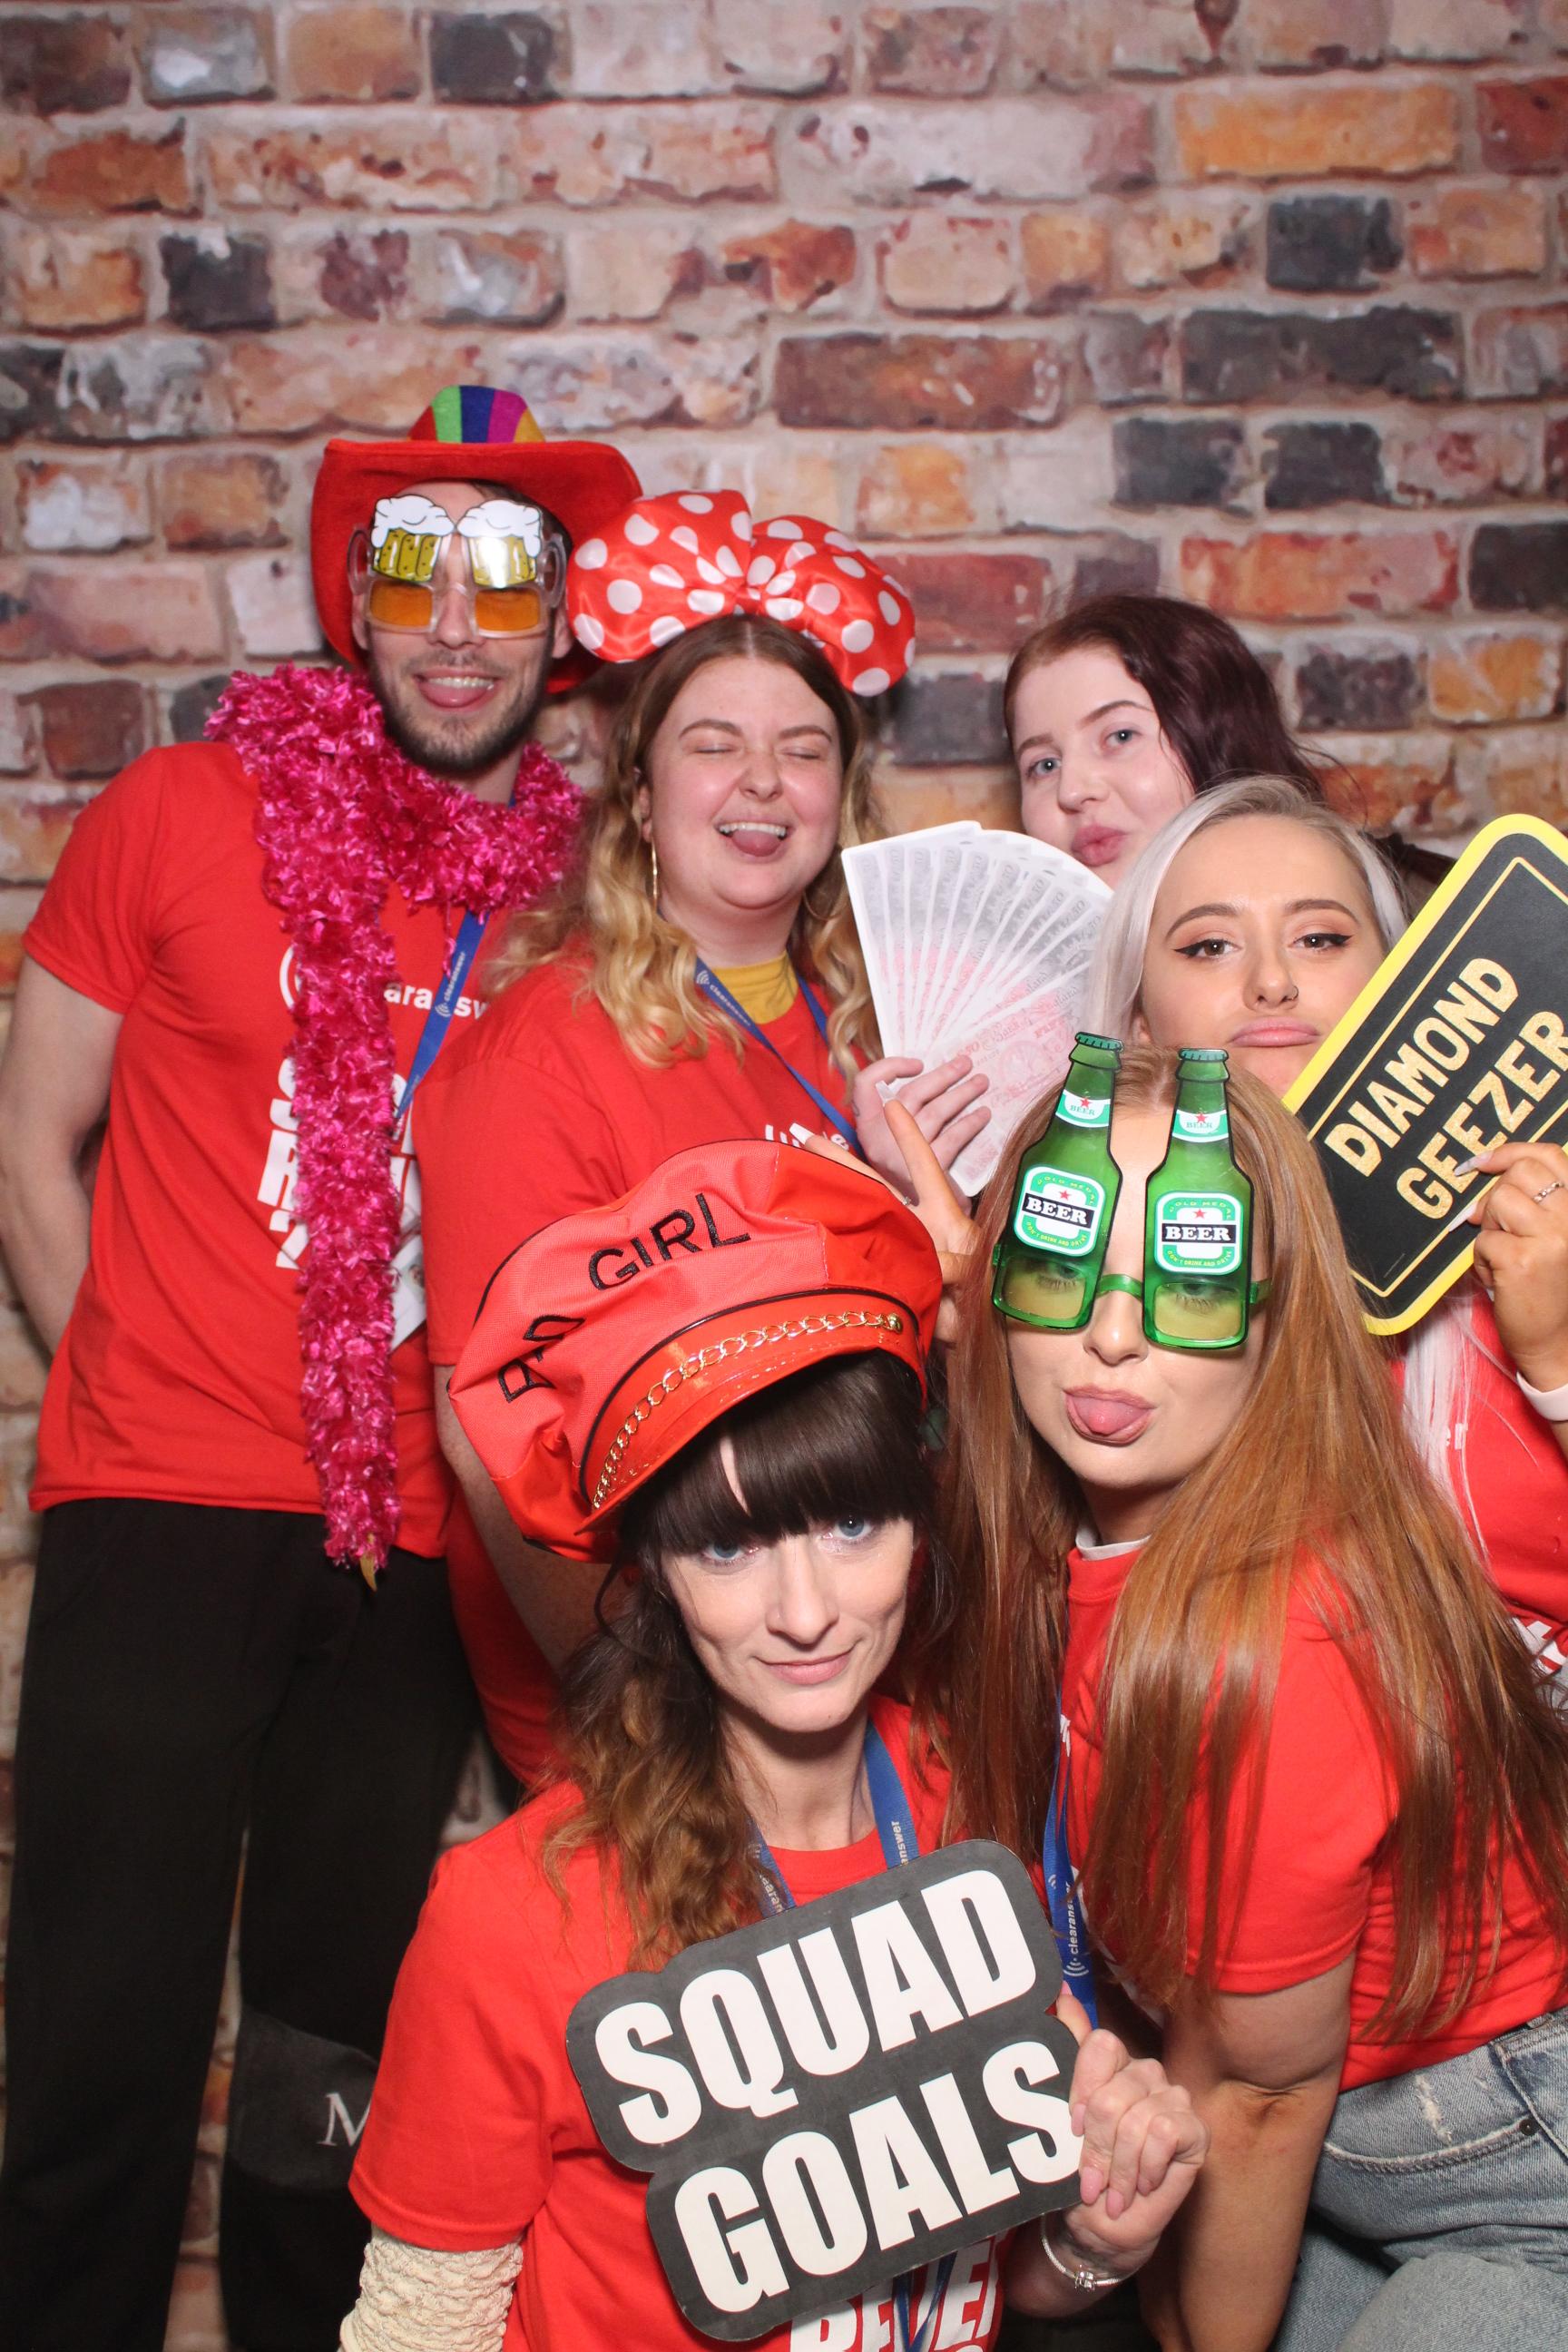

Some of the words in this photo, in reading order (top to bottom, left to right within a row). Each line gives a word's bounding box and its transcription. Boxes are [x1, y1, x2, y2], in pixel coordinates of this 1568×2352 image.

[1070, 1104, 1095, 1116] BEER
[1324, 958, 1518, 1177] DIAMOND
[1396, 1011, 1568, 1220] GEEZER
[1186, 1122, 1213, 1130] BEER
[588, 1193, 750, 1290] GIRL
[1025, 1197, 1087, 1225] BEER
[1165, 1226, 1231, 1241] BEER
[594, 1869, 1036, 2144] SQUAD
[674, 2041, 1083, 2312] GOALS
